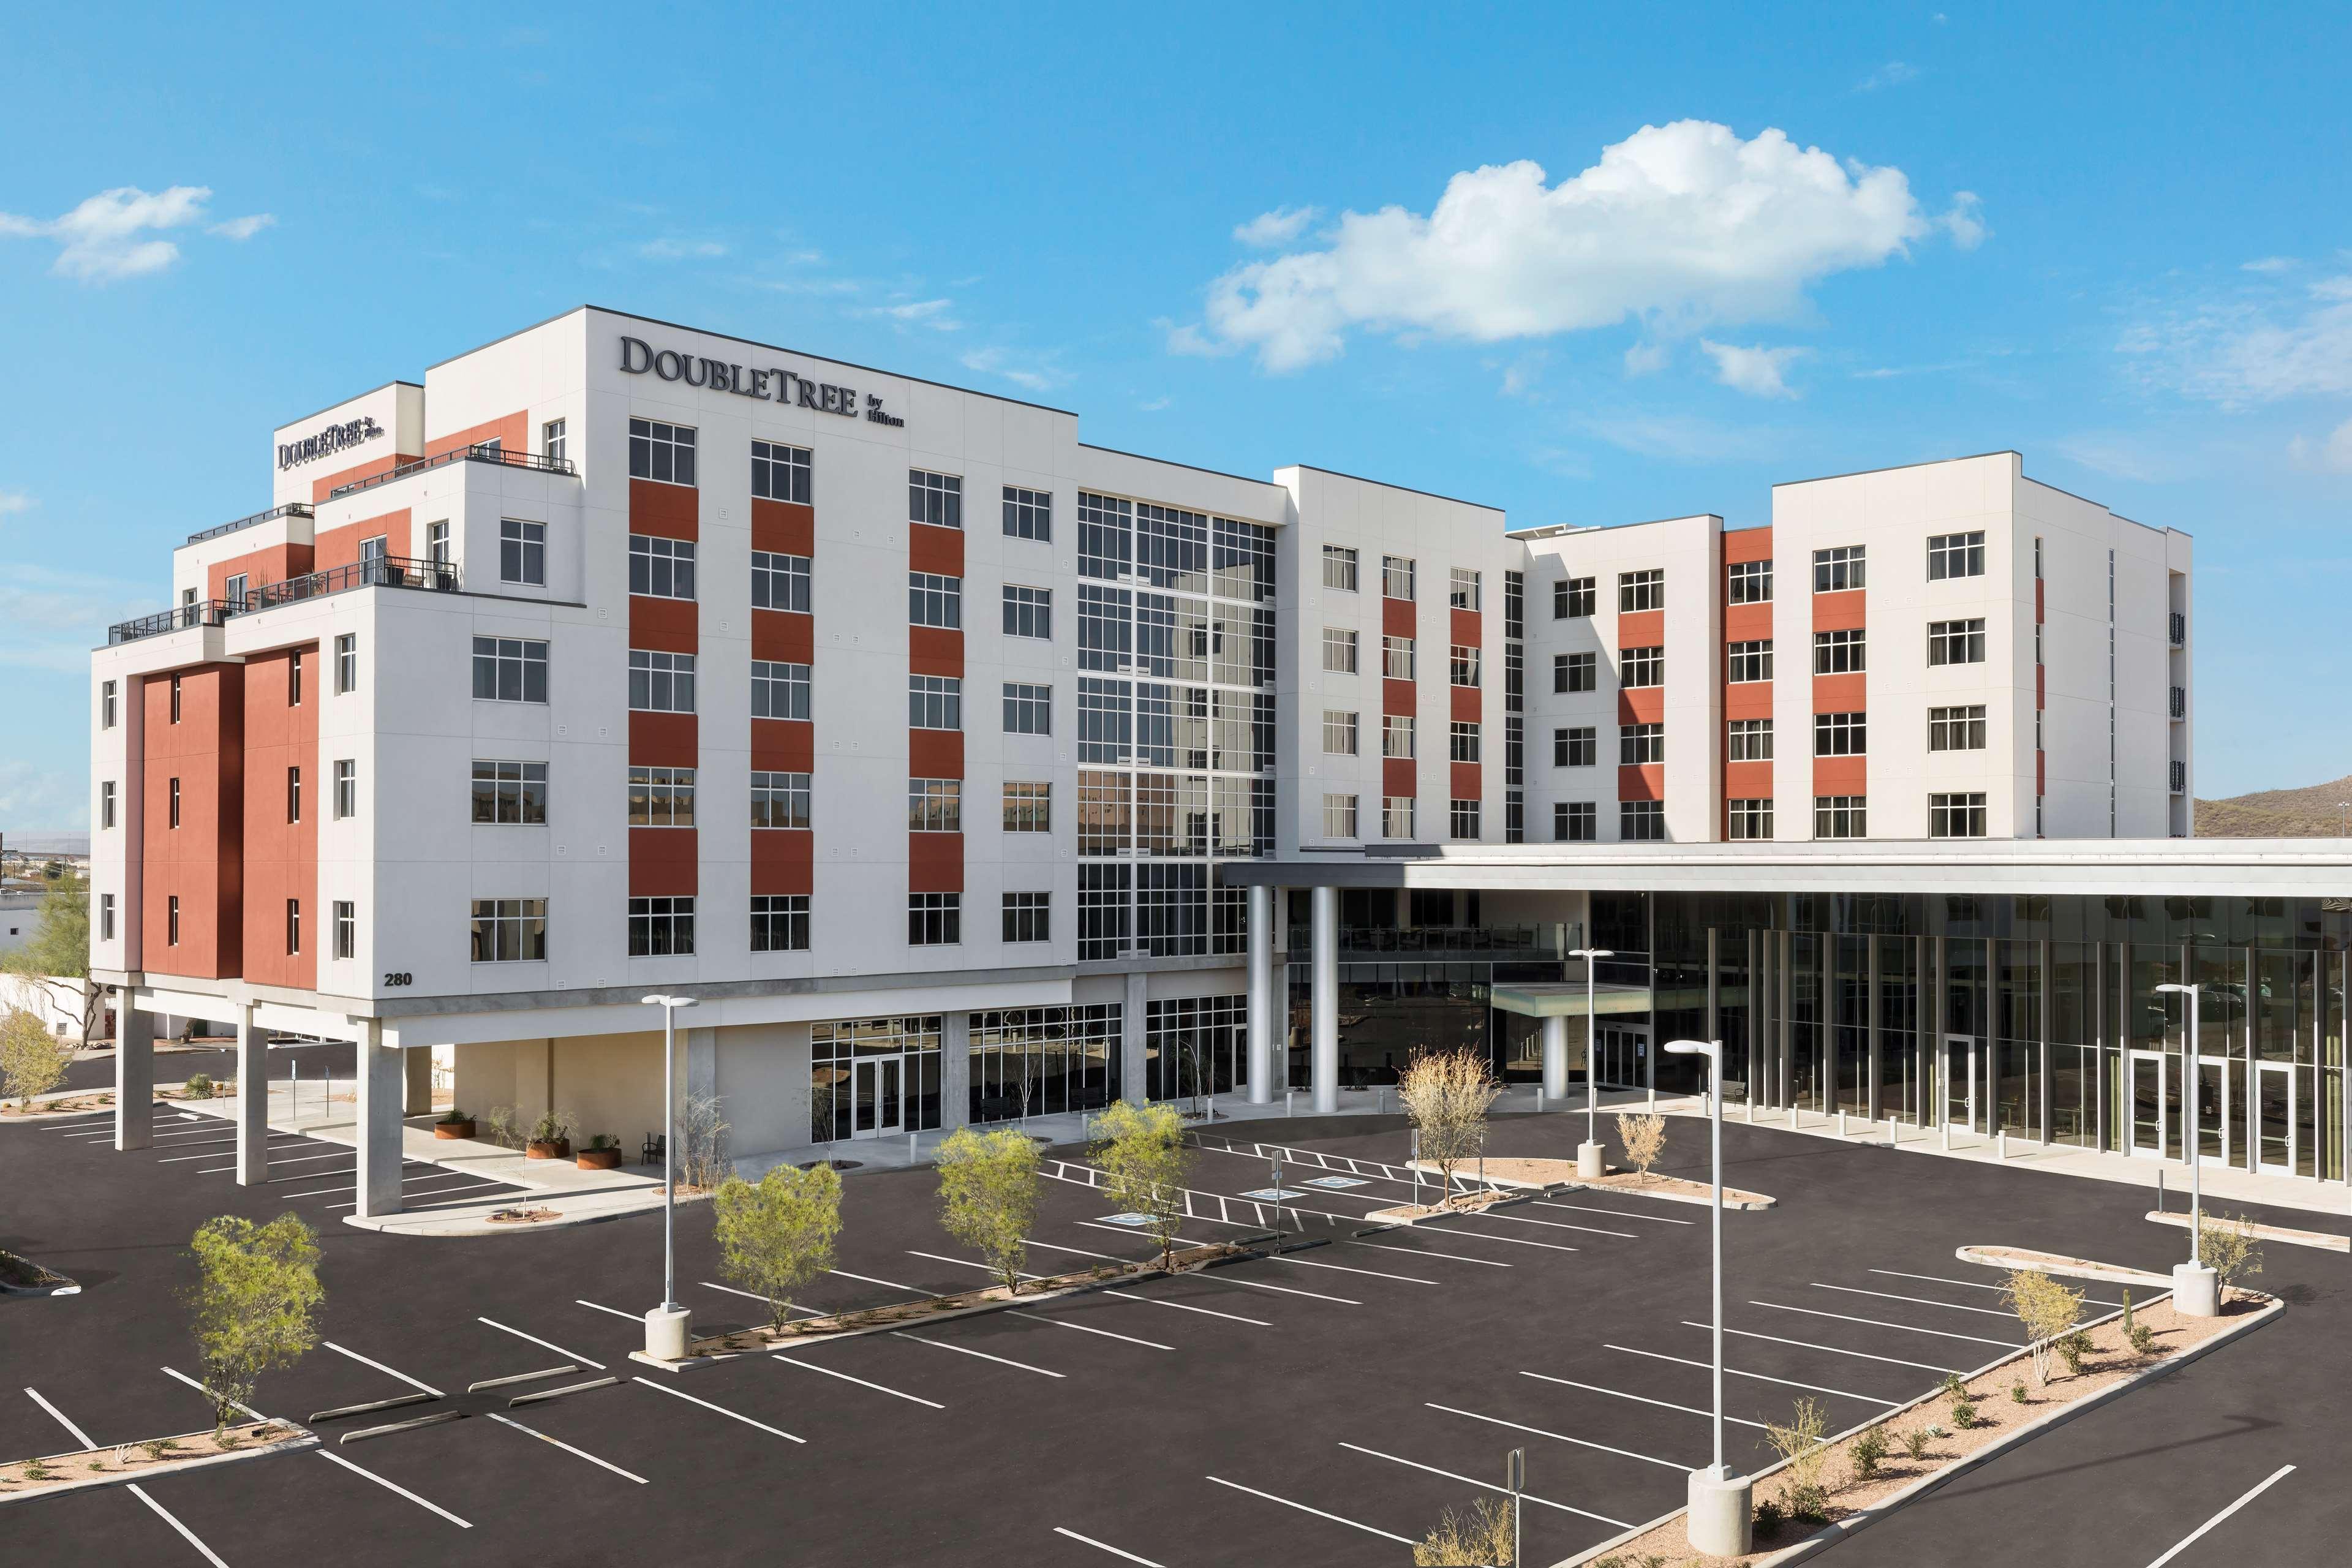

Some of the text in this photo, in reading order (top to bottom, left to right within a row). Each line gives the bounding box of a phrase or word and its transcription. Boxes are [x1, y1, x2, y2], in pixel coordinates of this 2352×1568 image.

[620, 336, 858, 417] DOUBLETREE
[867, 394, 883, 410] by
[867, 410, 905, 428] Hilton
[277, 419, 362, 469] DOUBLETREE
[384, 972, 412, 987] 280
